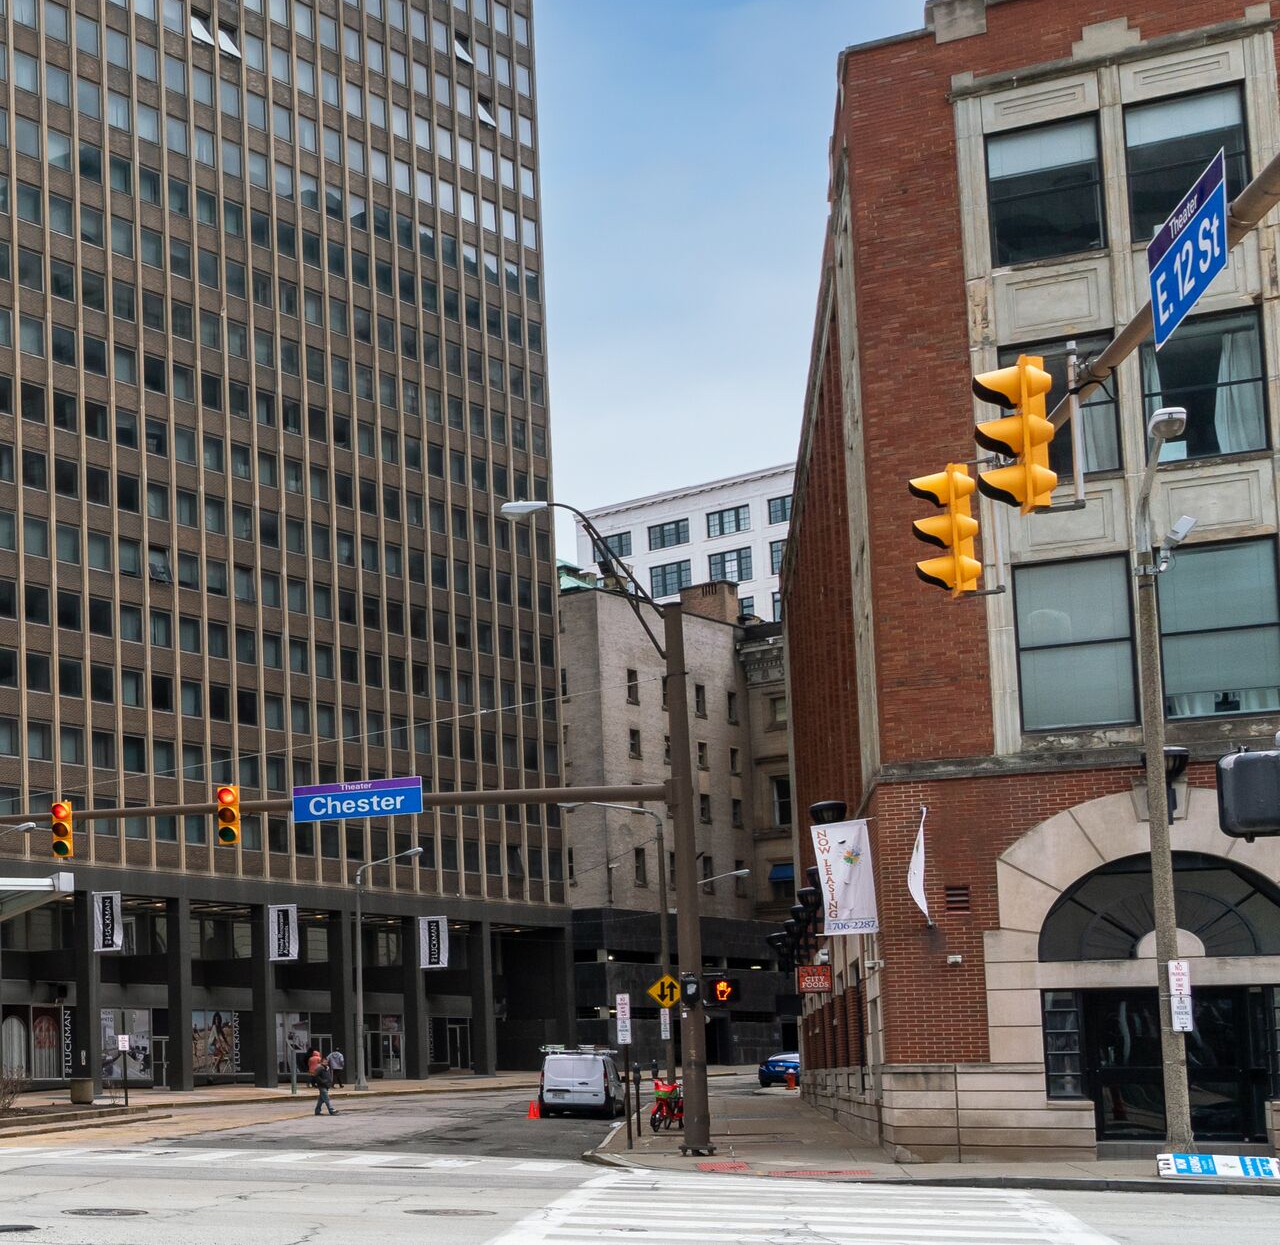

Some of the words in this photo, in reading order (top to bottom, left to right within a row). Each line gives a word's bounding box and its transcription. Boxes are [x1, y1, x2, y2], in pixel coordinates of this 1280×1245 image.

[1168, 194, 1198, 239] Theater
[1156, 271, 1174, 326] E.
[1174, 240, 1195, 301] 12
[1198, 212, 1220, 274] St
[309, 795, 405, 816] Chester
[340, 783, 372, 791] Theater
[816, 830, 831, 855] NOW
[824, 859, 838, 919] LEASING
[832, 920, 876, 931] 706-2287
[64, 1010, 72, 1066] LUCKMAN
